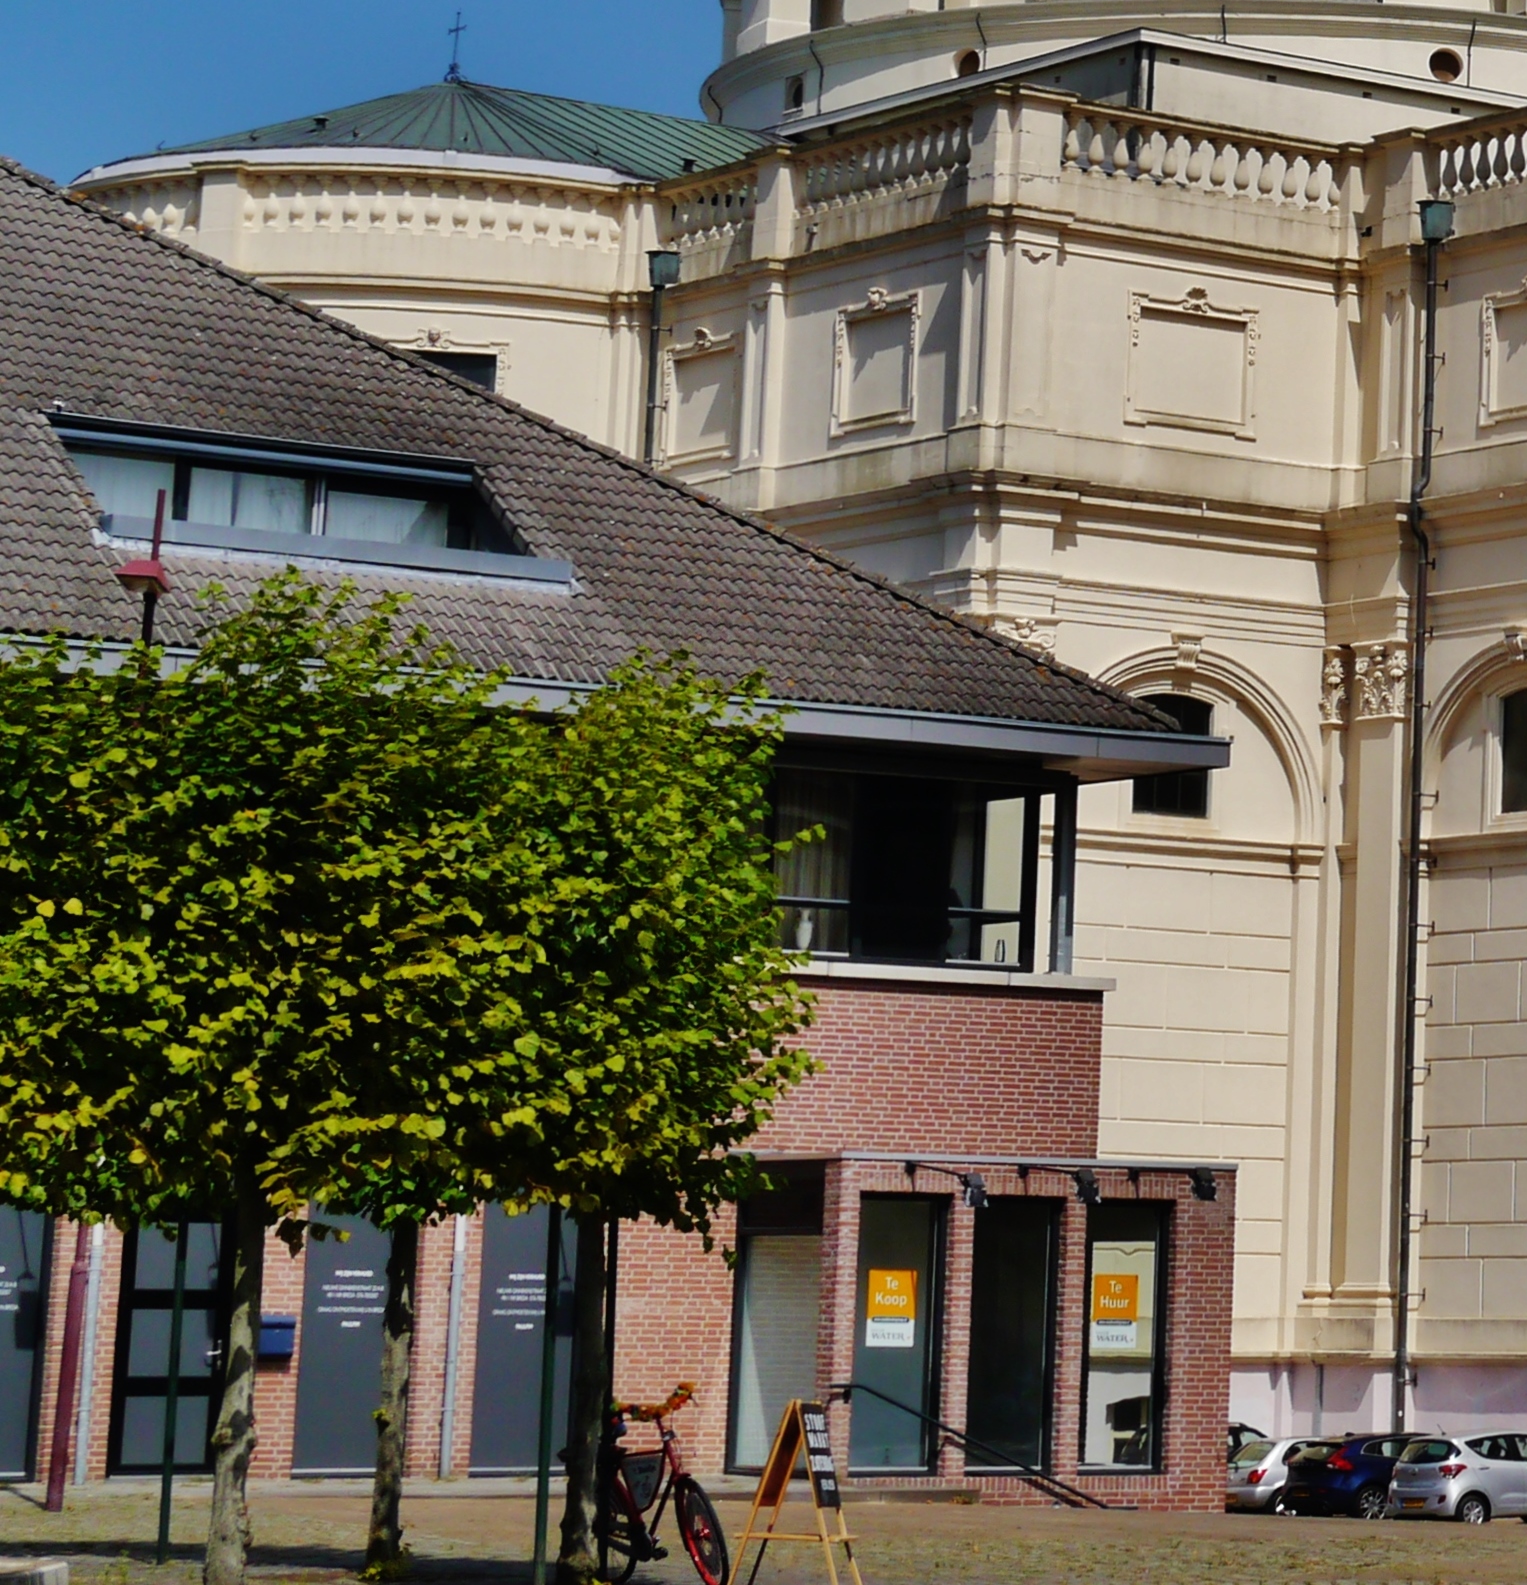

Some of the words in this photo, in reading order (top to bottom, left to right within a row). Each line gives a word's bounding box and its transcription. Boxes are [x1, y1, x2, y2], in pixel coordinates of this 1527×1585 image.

[885, 1276, 899, 1290] Te
[1109, 1280, 1123, 1294] Te
[875, 1291, 908, 1308] Koop
[1100, 1295, 1130, 1309] Huur
[871, 1331, 905, 1342] WATER
[1096, 1334, 1130, 1344] WATER
